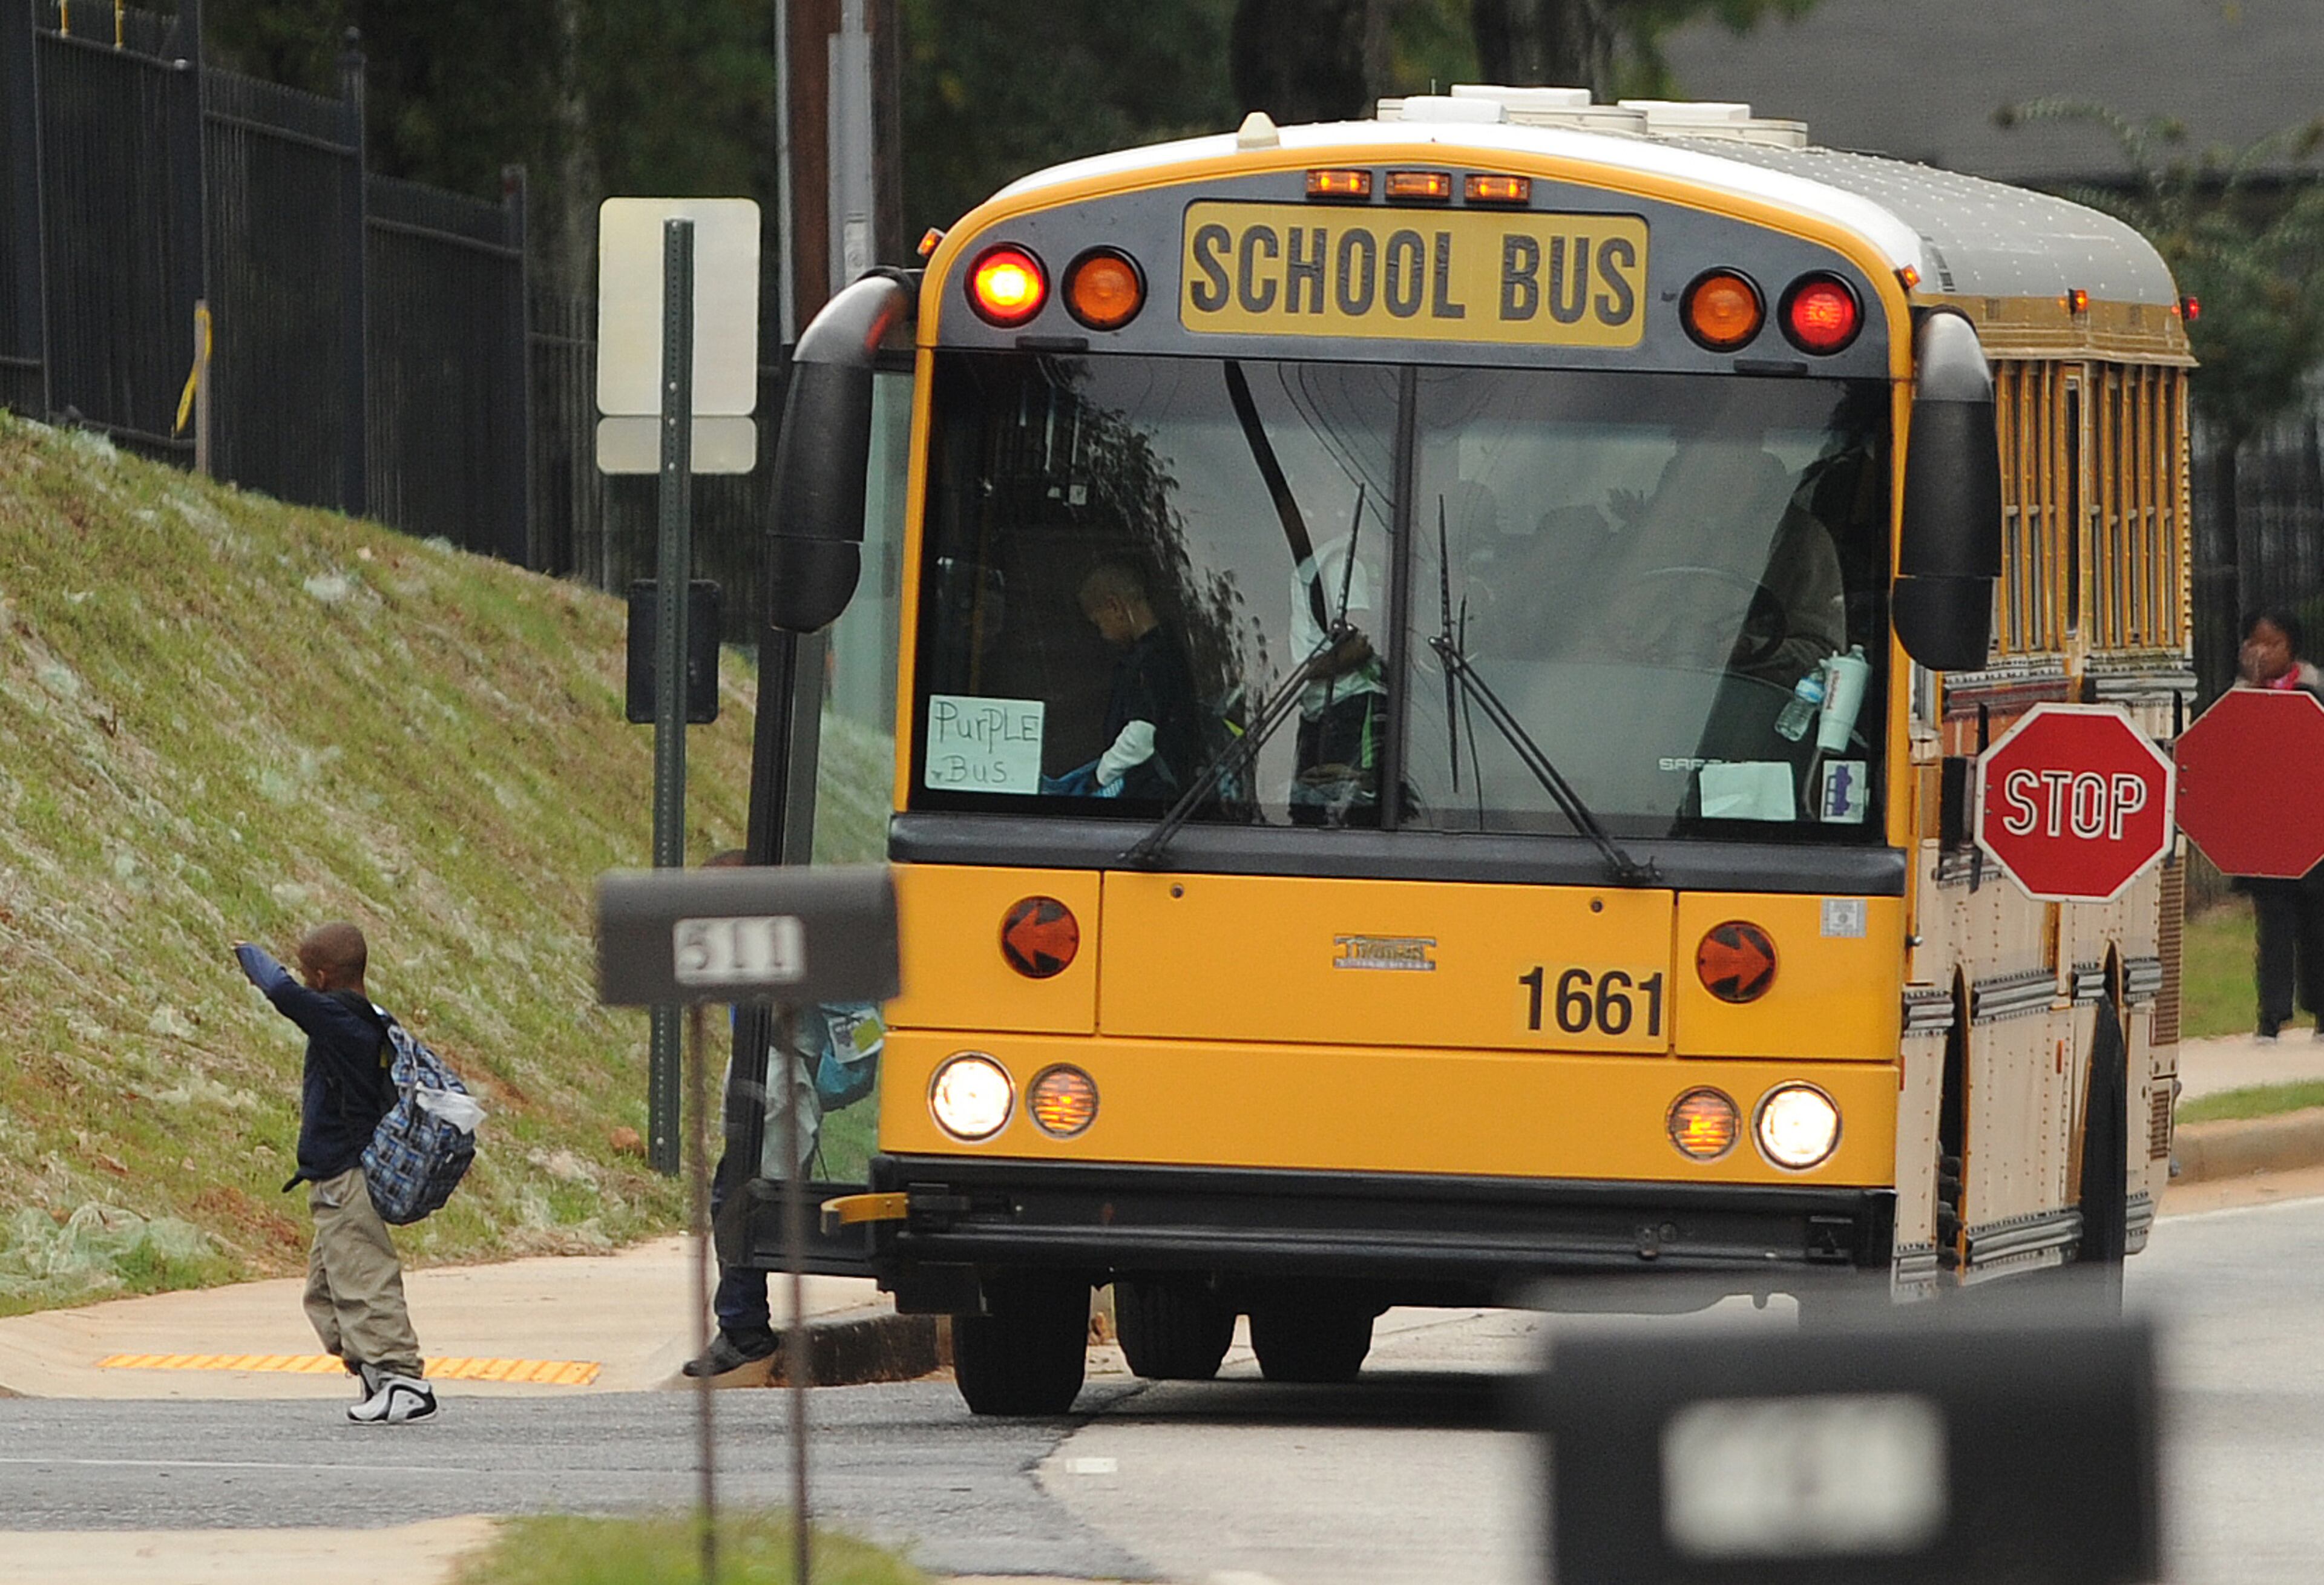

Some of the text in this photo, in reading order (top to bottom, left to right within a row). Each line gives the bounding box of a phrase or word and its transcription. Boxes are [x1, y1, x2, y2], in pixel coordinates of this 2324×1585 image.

[1190, 223, 1636, 326] SCHOOL BUS
[2003, 769, 2147, 840] STOP
[1518, 966, 1663, 1037] 1661
